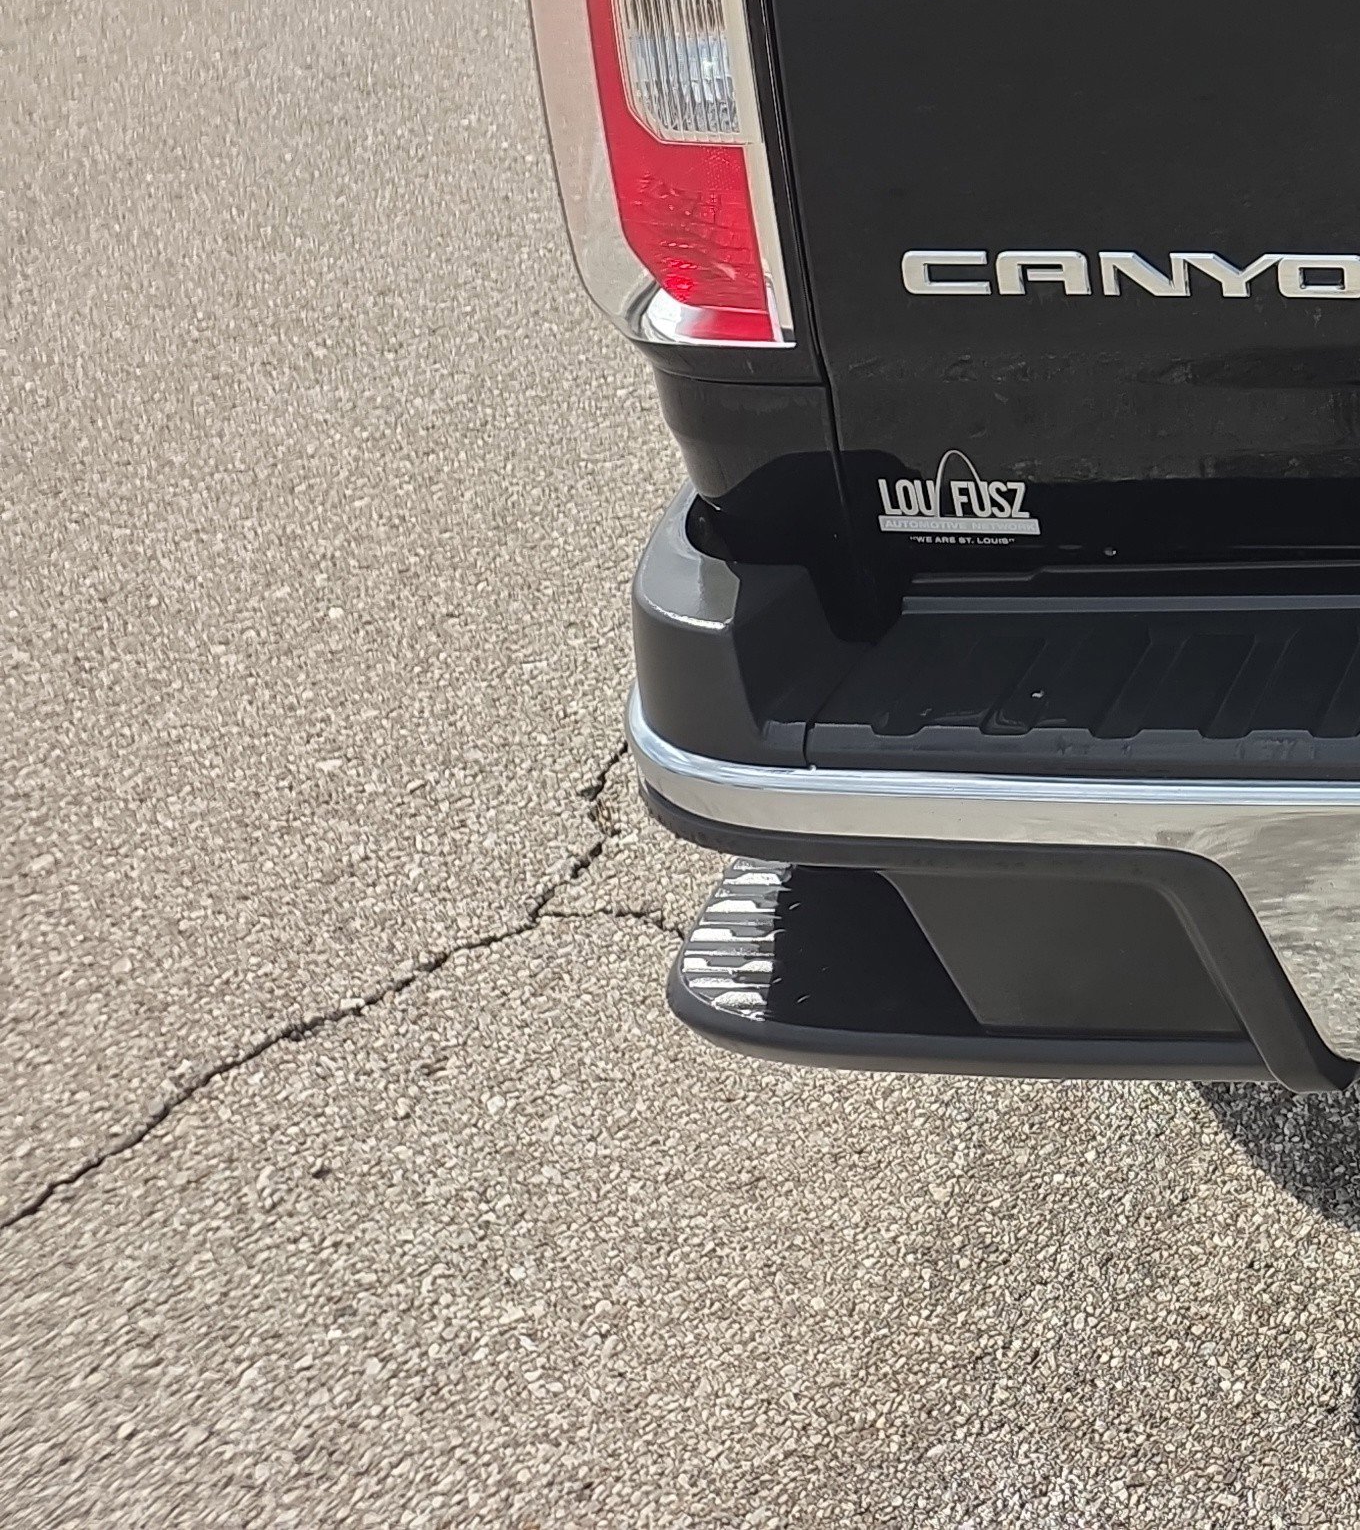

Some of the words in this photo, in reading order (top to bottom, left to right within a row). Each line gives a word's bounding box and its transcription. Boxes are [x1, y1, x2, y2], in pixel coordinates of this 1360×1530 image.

[877, 478, 937, 516] LOU
[950, 480, 1030, 519] FUSZ
[884, 519, 968, 531] AUTOMOTIVE
[971, 521, 1037, 532] NETWORK
[935, 536, 956, 544] ARE
[958, 536, 975, 545] ST.
